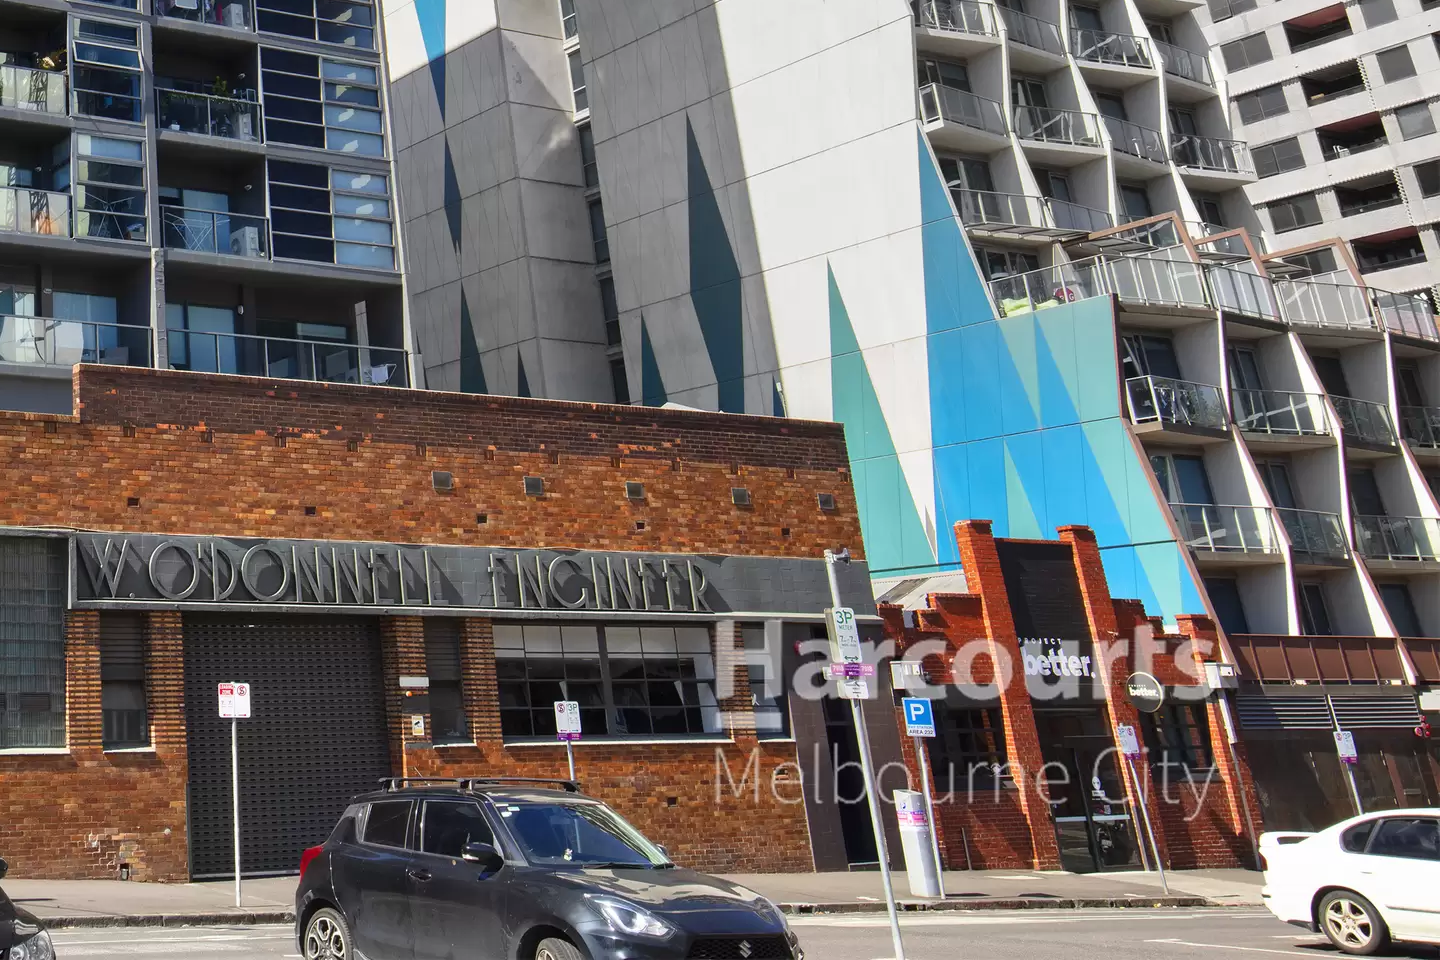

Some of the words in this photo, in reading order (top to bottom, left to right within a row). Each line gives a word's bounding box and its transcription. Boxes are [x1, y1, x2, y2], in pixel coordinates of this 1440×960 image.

[148, 540, 449, 606] O'DONNELL
[487, 552, 716, 613] ENGINEER
[835, 610, 852, 624] 3P
[1020, 646, 1096, 678] better.
[1129, 686, 1158, 696] better.
[568, 703, 578, 711] 3P
[910, 704, 924, 721] P
